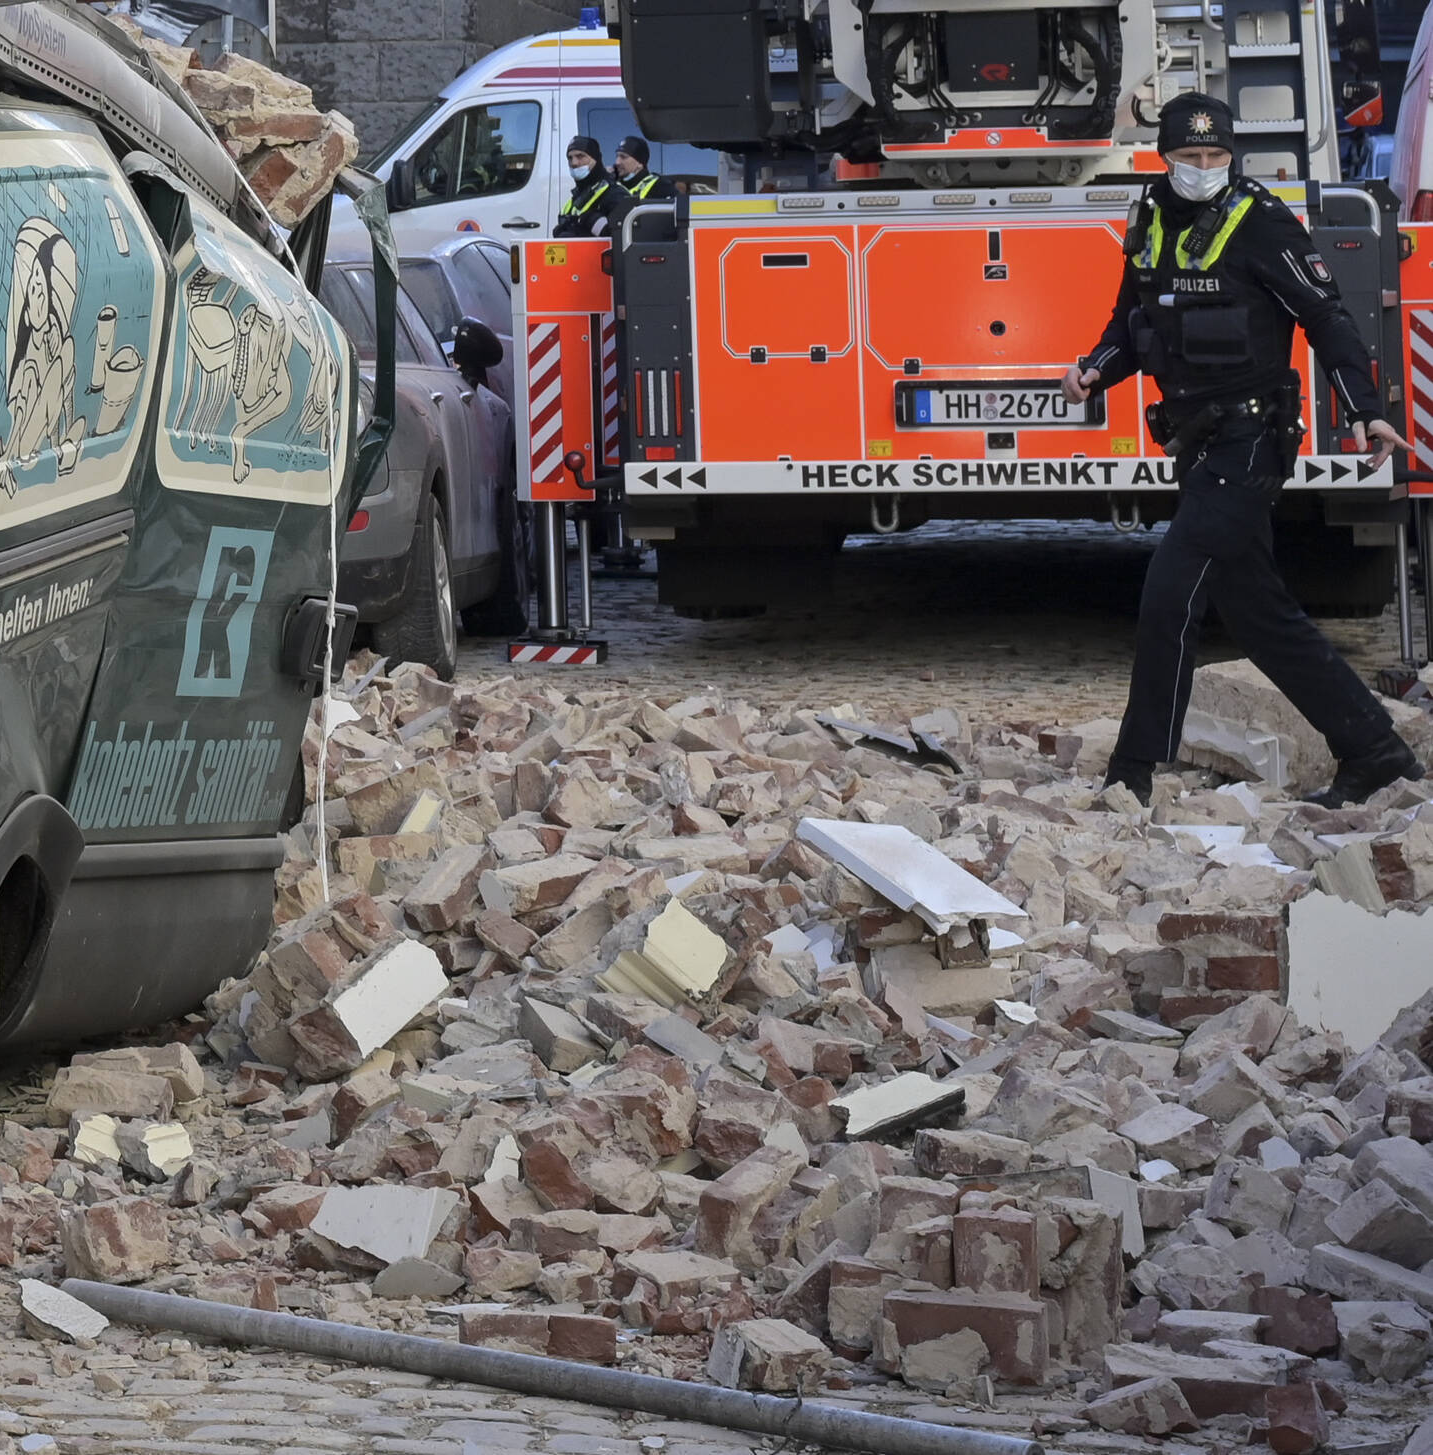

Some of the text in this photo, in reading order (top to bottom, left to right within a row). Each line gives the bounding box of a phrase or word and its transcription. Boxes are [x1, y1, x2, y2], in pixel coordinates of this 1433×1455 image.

[1185, 134, 1219, 143] POLIZEI
[1172, 277, 1220, 292] POLIZEI
[945, 393, 981, 419] HH
[999, 393, 1068, 419] 2670
[801, 462, 900, 489] HECK
[913, 461, 1118, 487] SCHWENKT
[68, 720, 196, 830] kobelentz
[185, 720, 282, 825] sanitär
